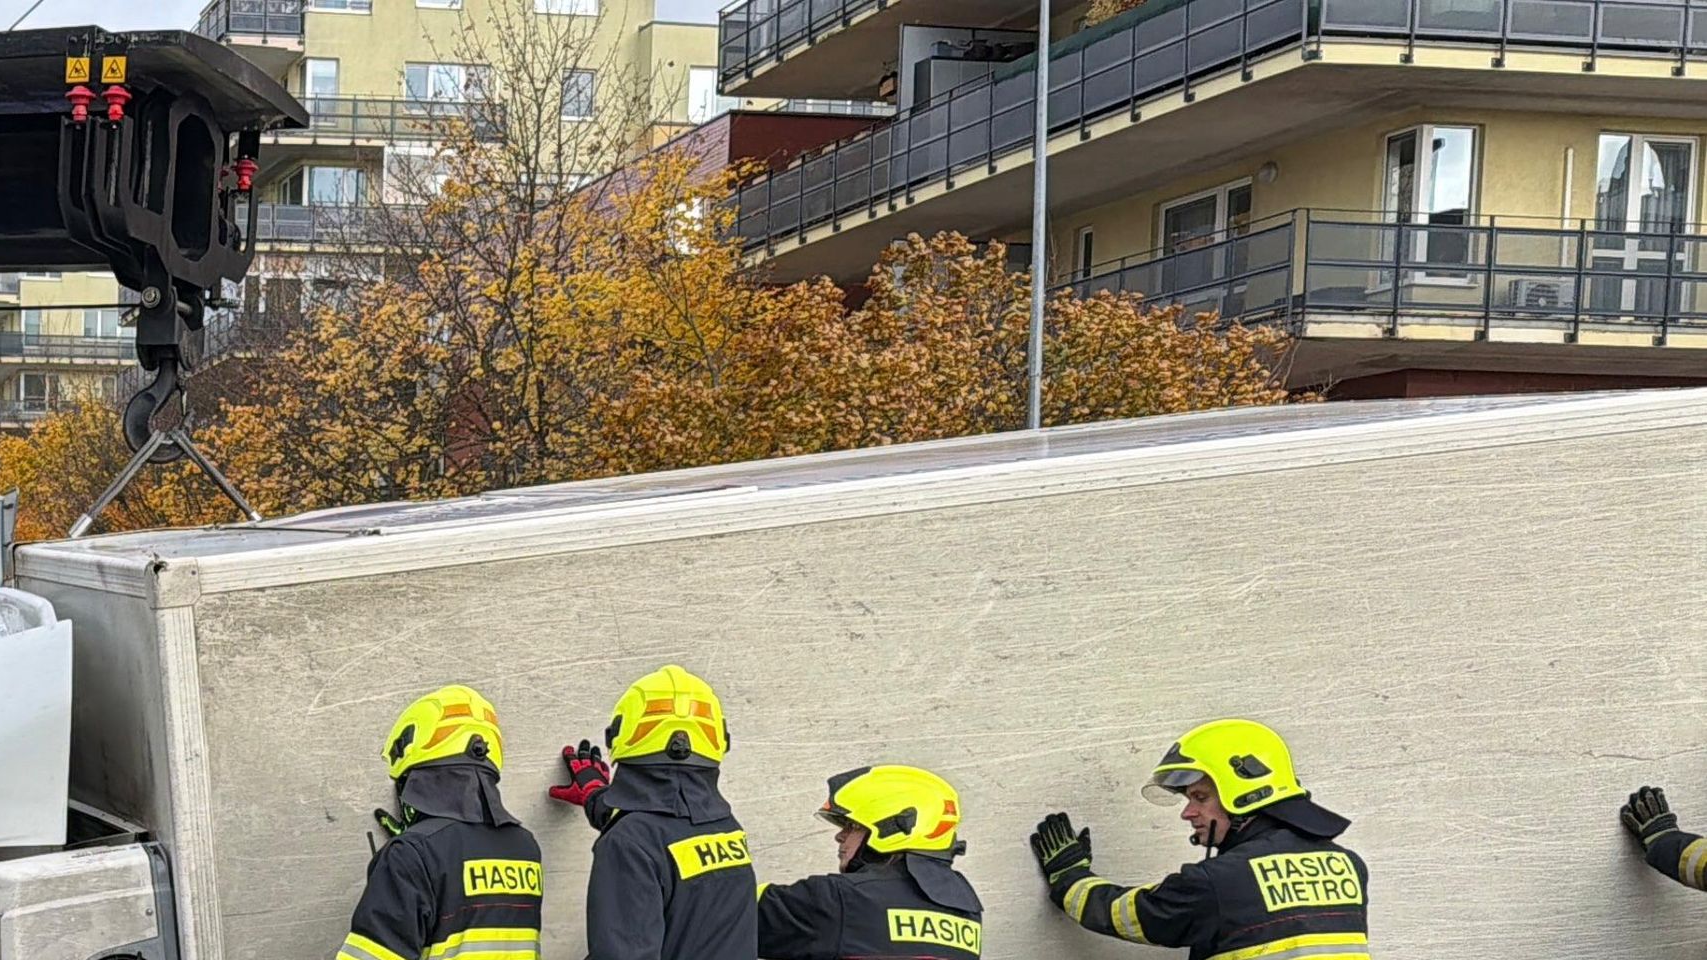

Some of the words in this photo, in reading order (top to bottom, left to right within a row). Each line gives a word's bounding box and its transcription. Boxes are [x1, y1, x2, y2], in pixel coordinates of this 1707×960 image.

[469, 863, 541, 891] HASIČI
[1256, 853, 1353, 883] HASIČI
[1266, 878, 1359, 906] METRO
[894, 915, 979, 950] HASIČI
